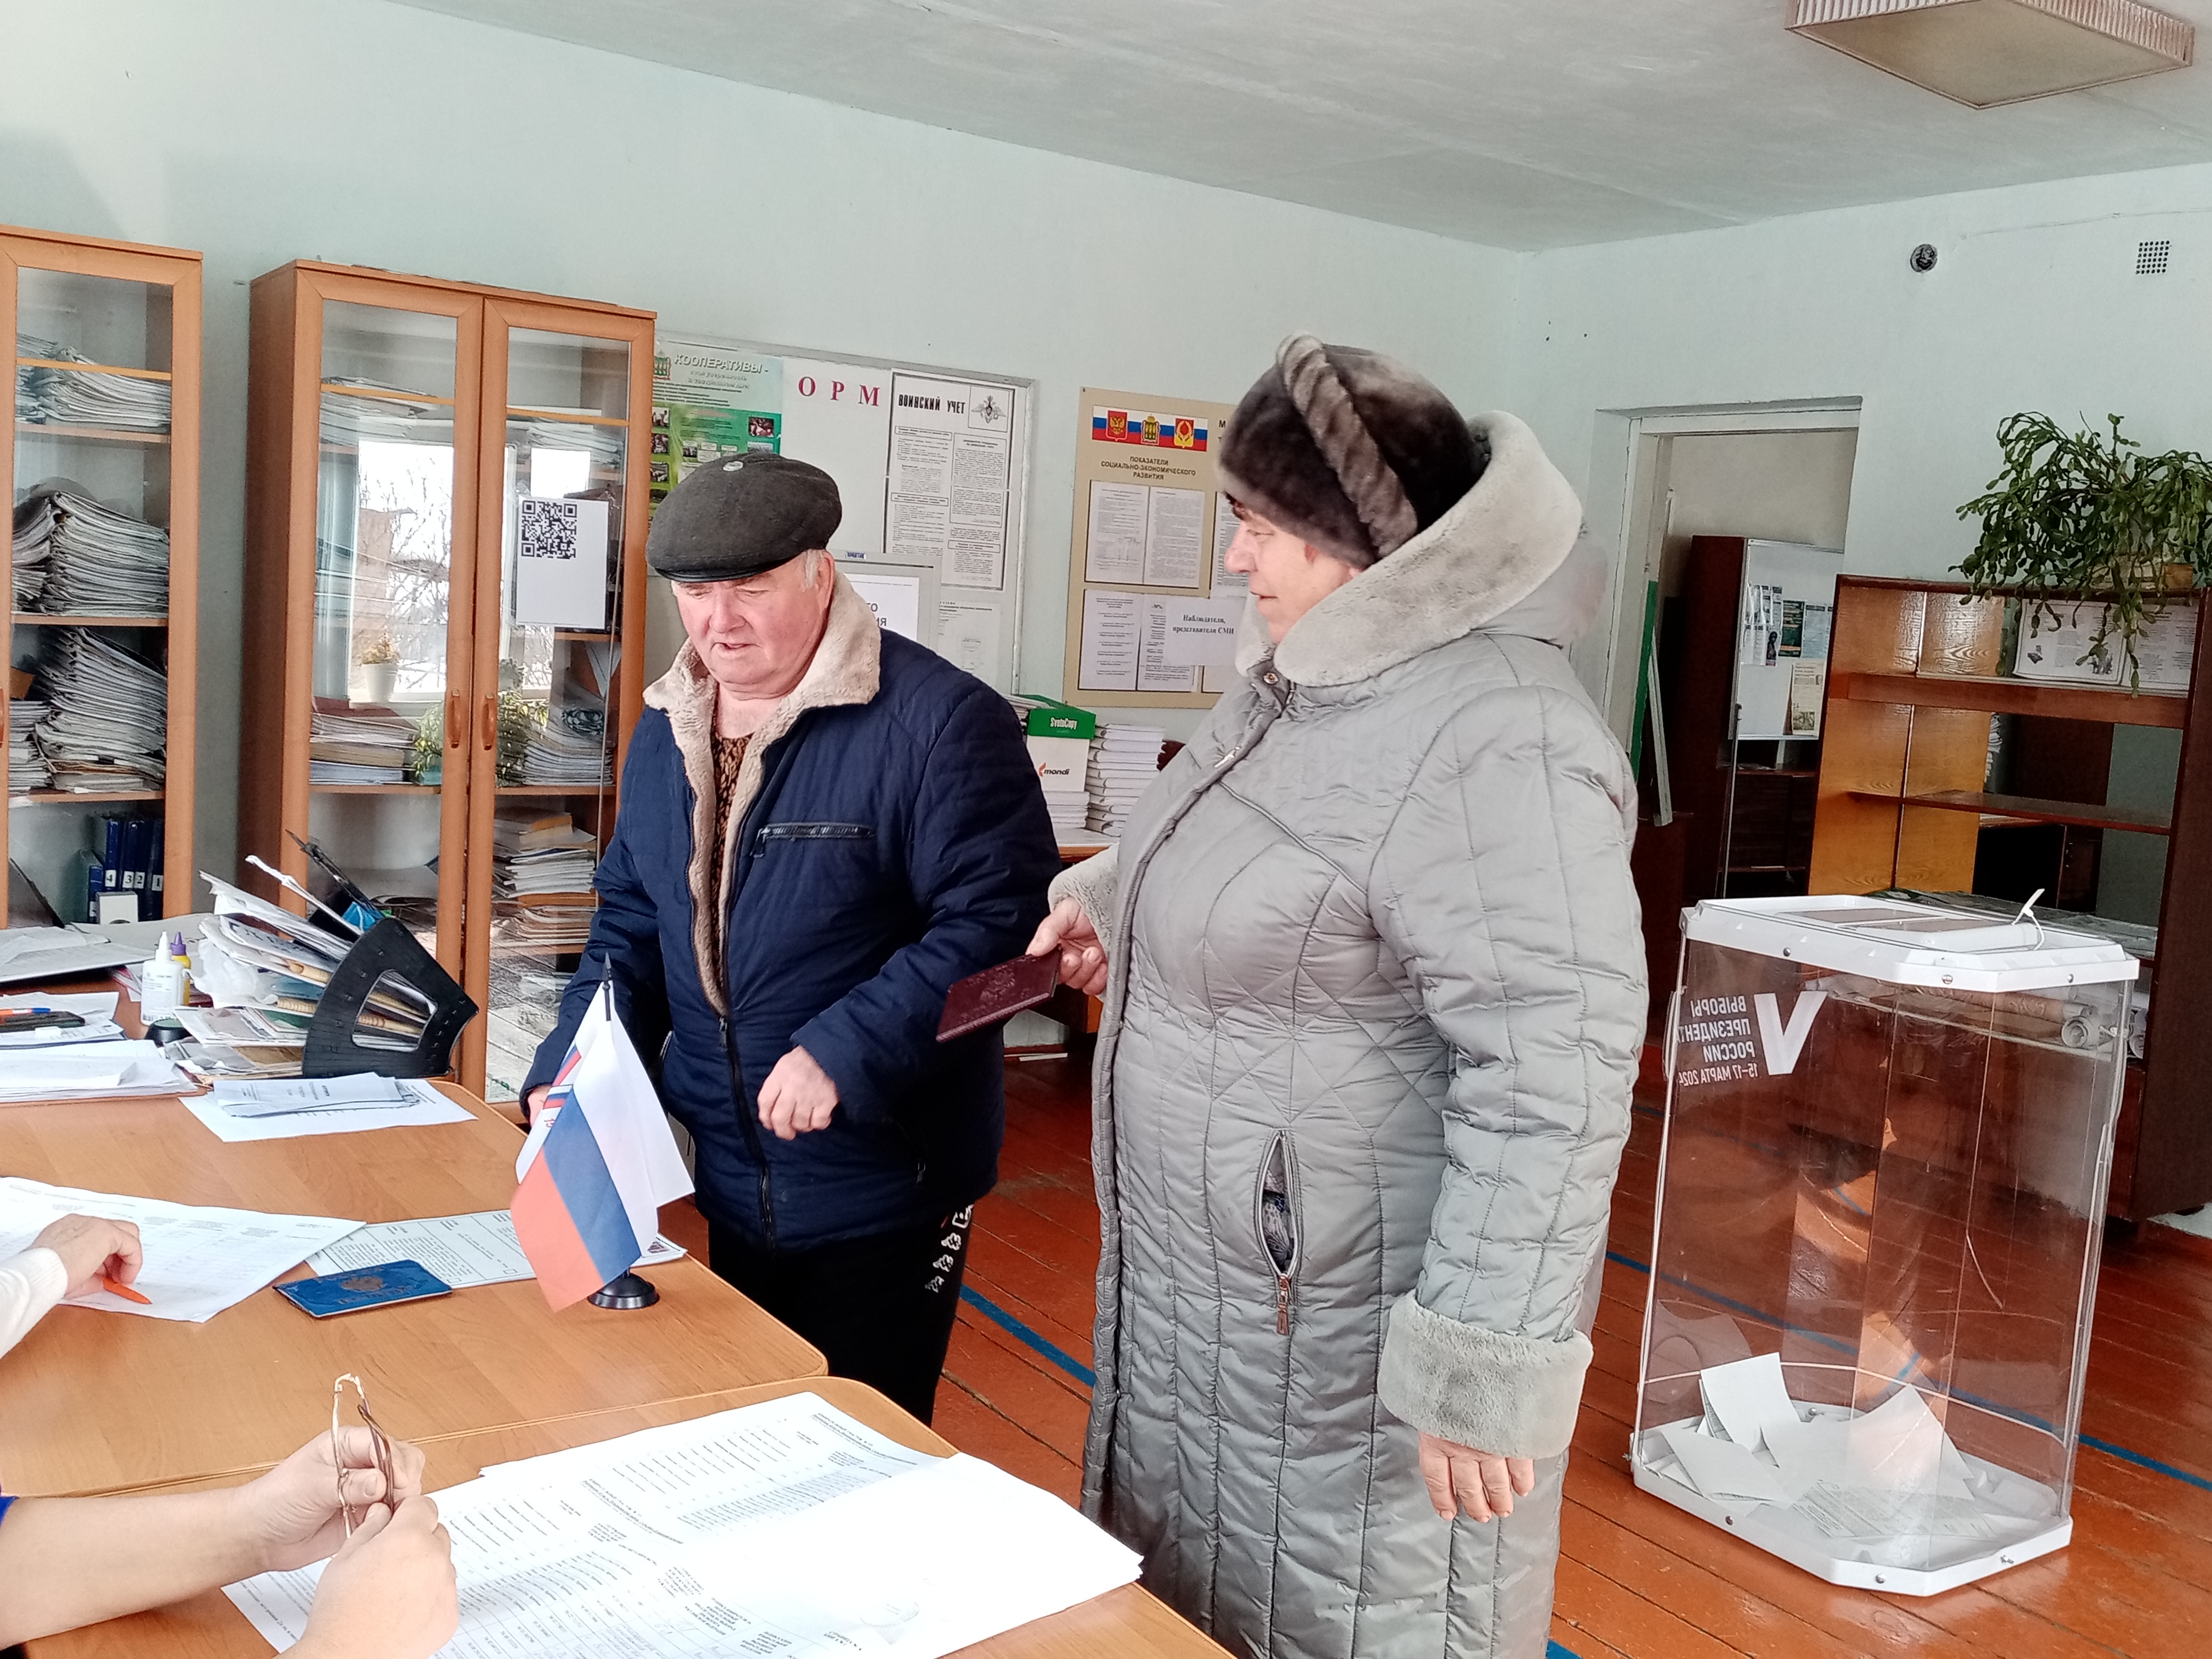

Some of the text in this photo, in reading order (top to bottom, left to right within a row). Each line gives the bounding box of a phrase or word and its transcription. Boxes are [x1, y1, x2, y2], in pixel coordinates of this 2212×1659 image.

[674, 354, 763, 374] КООПЕРАТИВЫ
[899, 394, 966, 414] ВОИНСКИЙ УЧЕТ
[1130, 456, 1169, 466] ПОКАЗАТЕЛИ
[1101, 460, 1196, 476] СОЦИАЛЬНО-ЭКОНОМИЧЕСКОГО
[1133, 472, 1164, 480] РАЗВИТИЯ
[1050, 717, 1078, 730] SvetoCopy
[125, 875, 132, 884] 3
[137, 875, 143, 884] 2
